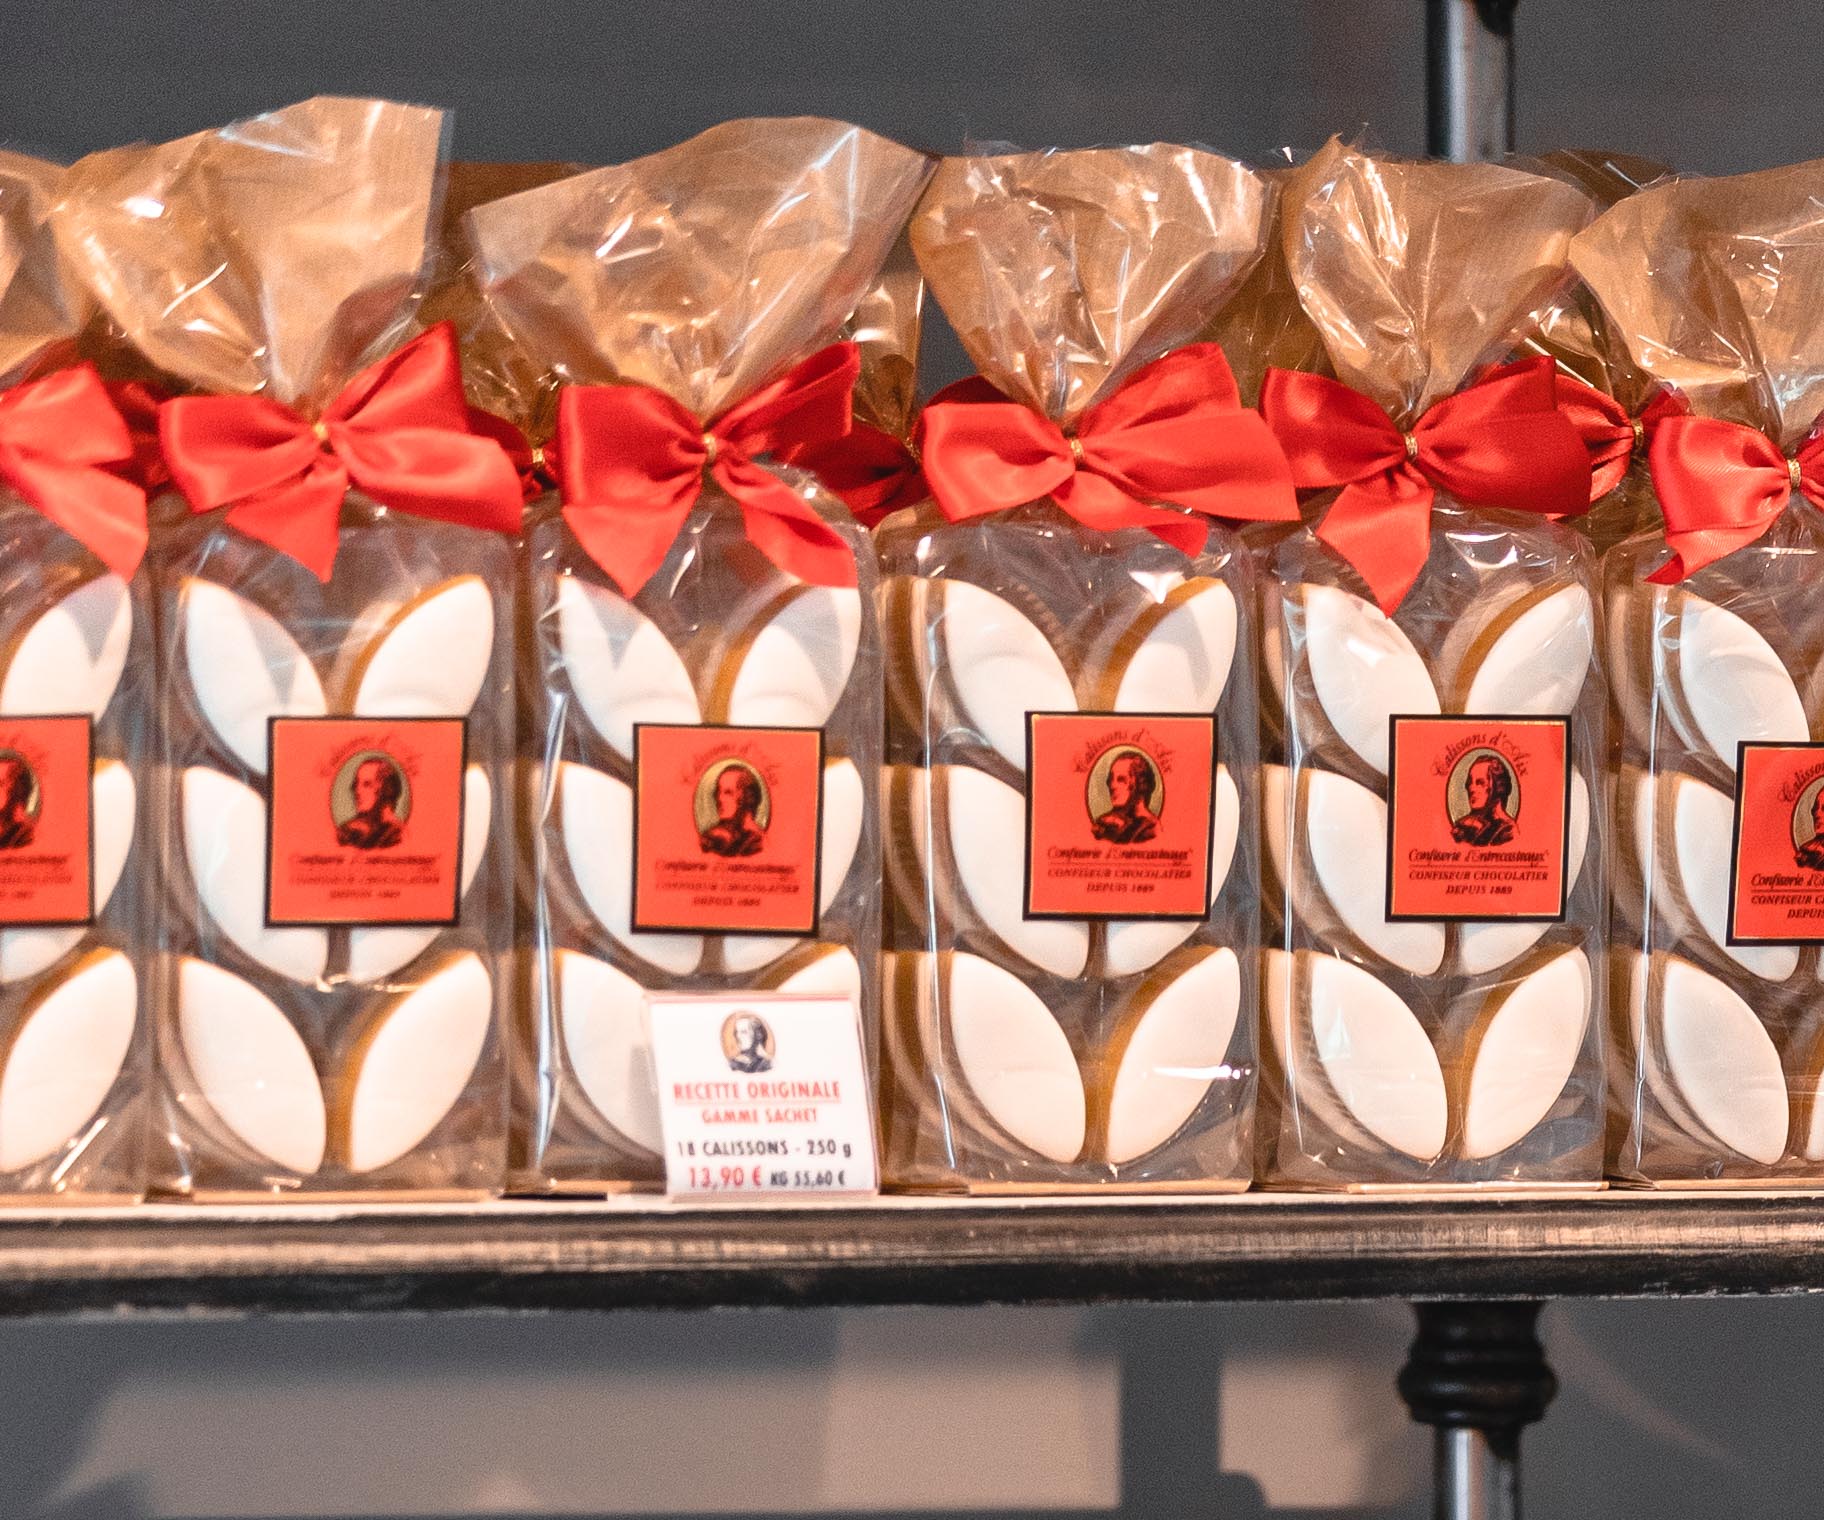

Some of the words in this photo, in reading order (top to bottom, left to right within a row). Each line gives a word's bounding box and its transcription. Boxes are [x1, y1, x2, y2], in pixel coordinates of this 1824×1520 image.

[1409, 871, 1470, 880] CONFISEUR
[1473, 871, 1549, 881] CHOCOLATIER
[1445, 885, 1486, 894] DEPUIS
[1751, 895, 1812, 904] CONFISEUR
[673, 1082, 739, 1099] RECETTE
[747, 1081, 840, 1099] ORIGINALE
[702, 1109, 758, 1123] GAMME
[766, 1108, 817, 1122] SACHET
[678, 1141, 695, 1156] 18
[703, 1140, 789, 1155] CALISSONS
[807, 1139, 837, 1155] 250
[843, 1143, 852, 1158] g
[689, 1167, 744, 1190] 13,90
[752, 1166, 762, 1186] €
[770, 1171, 788, 1186] KG
[794, 1170, 833, 1187] 55,60
